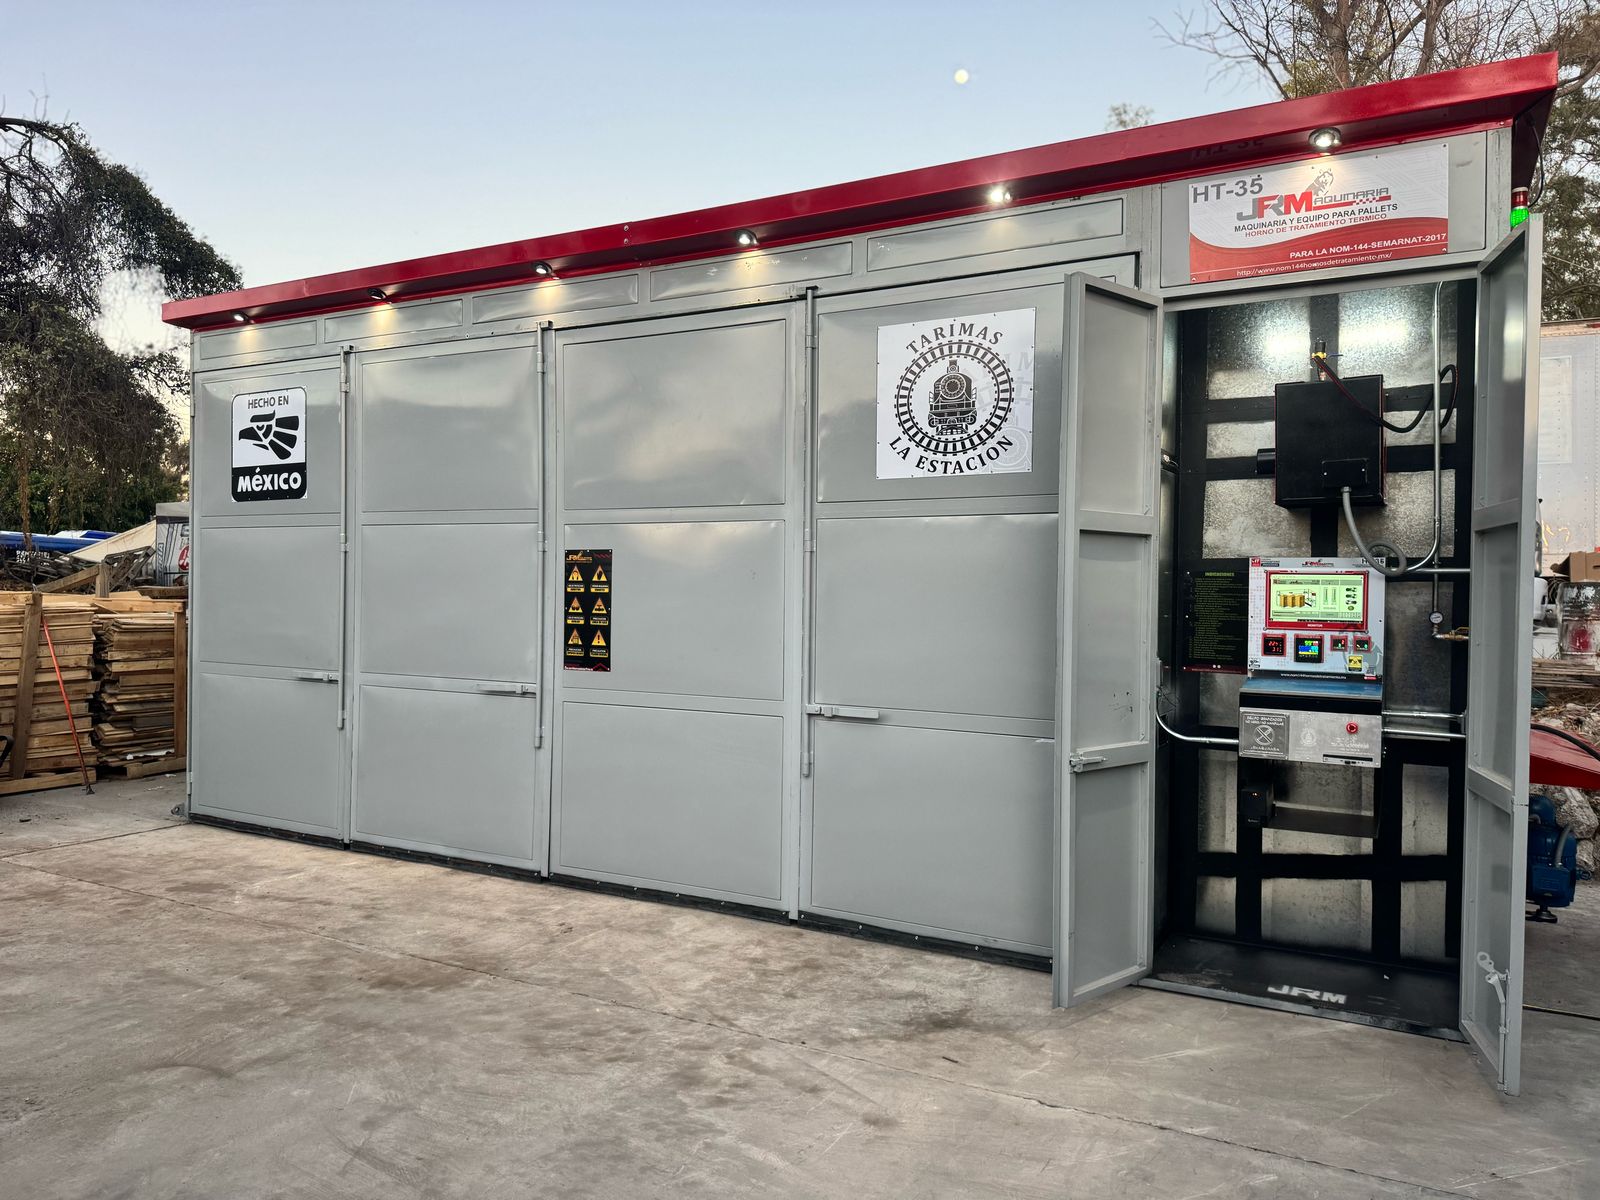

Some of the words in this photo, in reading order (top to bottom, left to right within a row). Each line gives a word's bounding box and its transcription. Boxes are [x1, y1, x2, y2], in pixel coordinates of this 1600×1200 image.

[1193, 177, 1264, 203] HT-35
[1234, 218, 1287, 233] MAQUINARIA
[1288, 217, 1295, 225] Y
[1296, 213, 1330, 224] EQUIPO
[1331, 210, 1356, 219] PARA
[1357, 203, 1398, 216] PALLETS
[1244, 228, 1274, 238] HORNO
[1276, 226, 1287, 234] DE
[1289, 219, 1347, 232] TRATAMIENTO
[1348, 213, 1387, 224] TERMICO
[1289, 250, 1314, 259] PARA
[1316, 248, 1327, 256] LA
[1329, 233, 1447, 254] NOM-144-SEMARNAT-2017
[1236, 252, 1393, 277] http://www.nom144honosdetratamiento.mx/
[906, 322, 1003, 355] TARIMAS
[247, 396, 276, 410] HECHO
[277, 395, 289, 406] EN
[889, 436, 908, 461] LA
[915, 435, 1014, 475] ESTACION
[1266, 984, 1348, 1005] JRM
